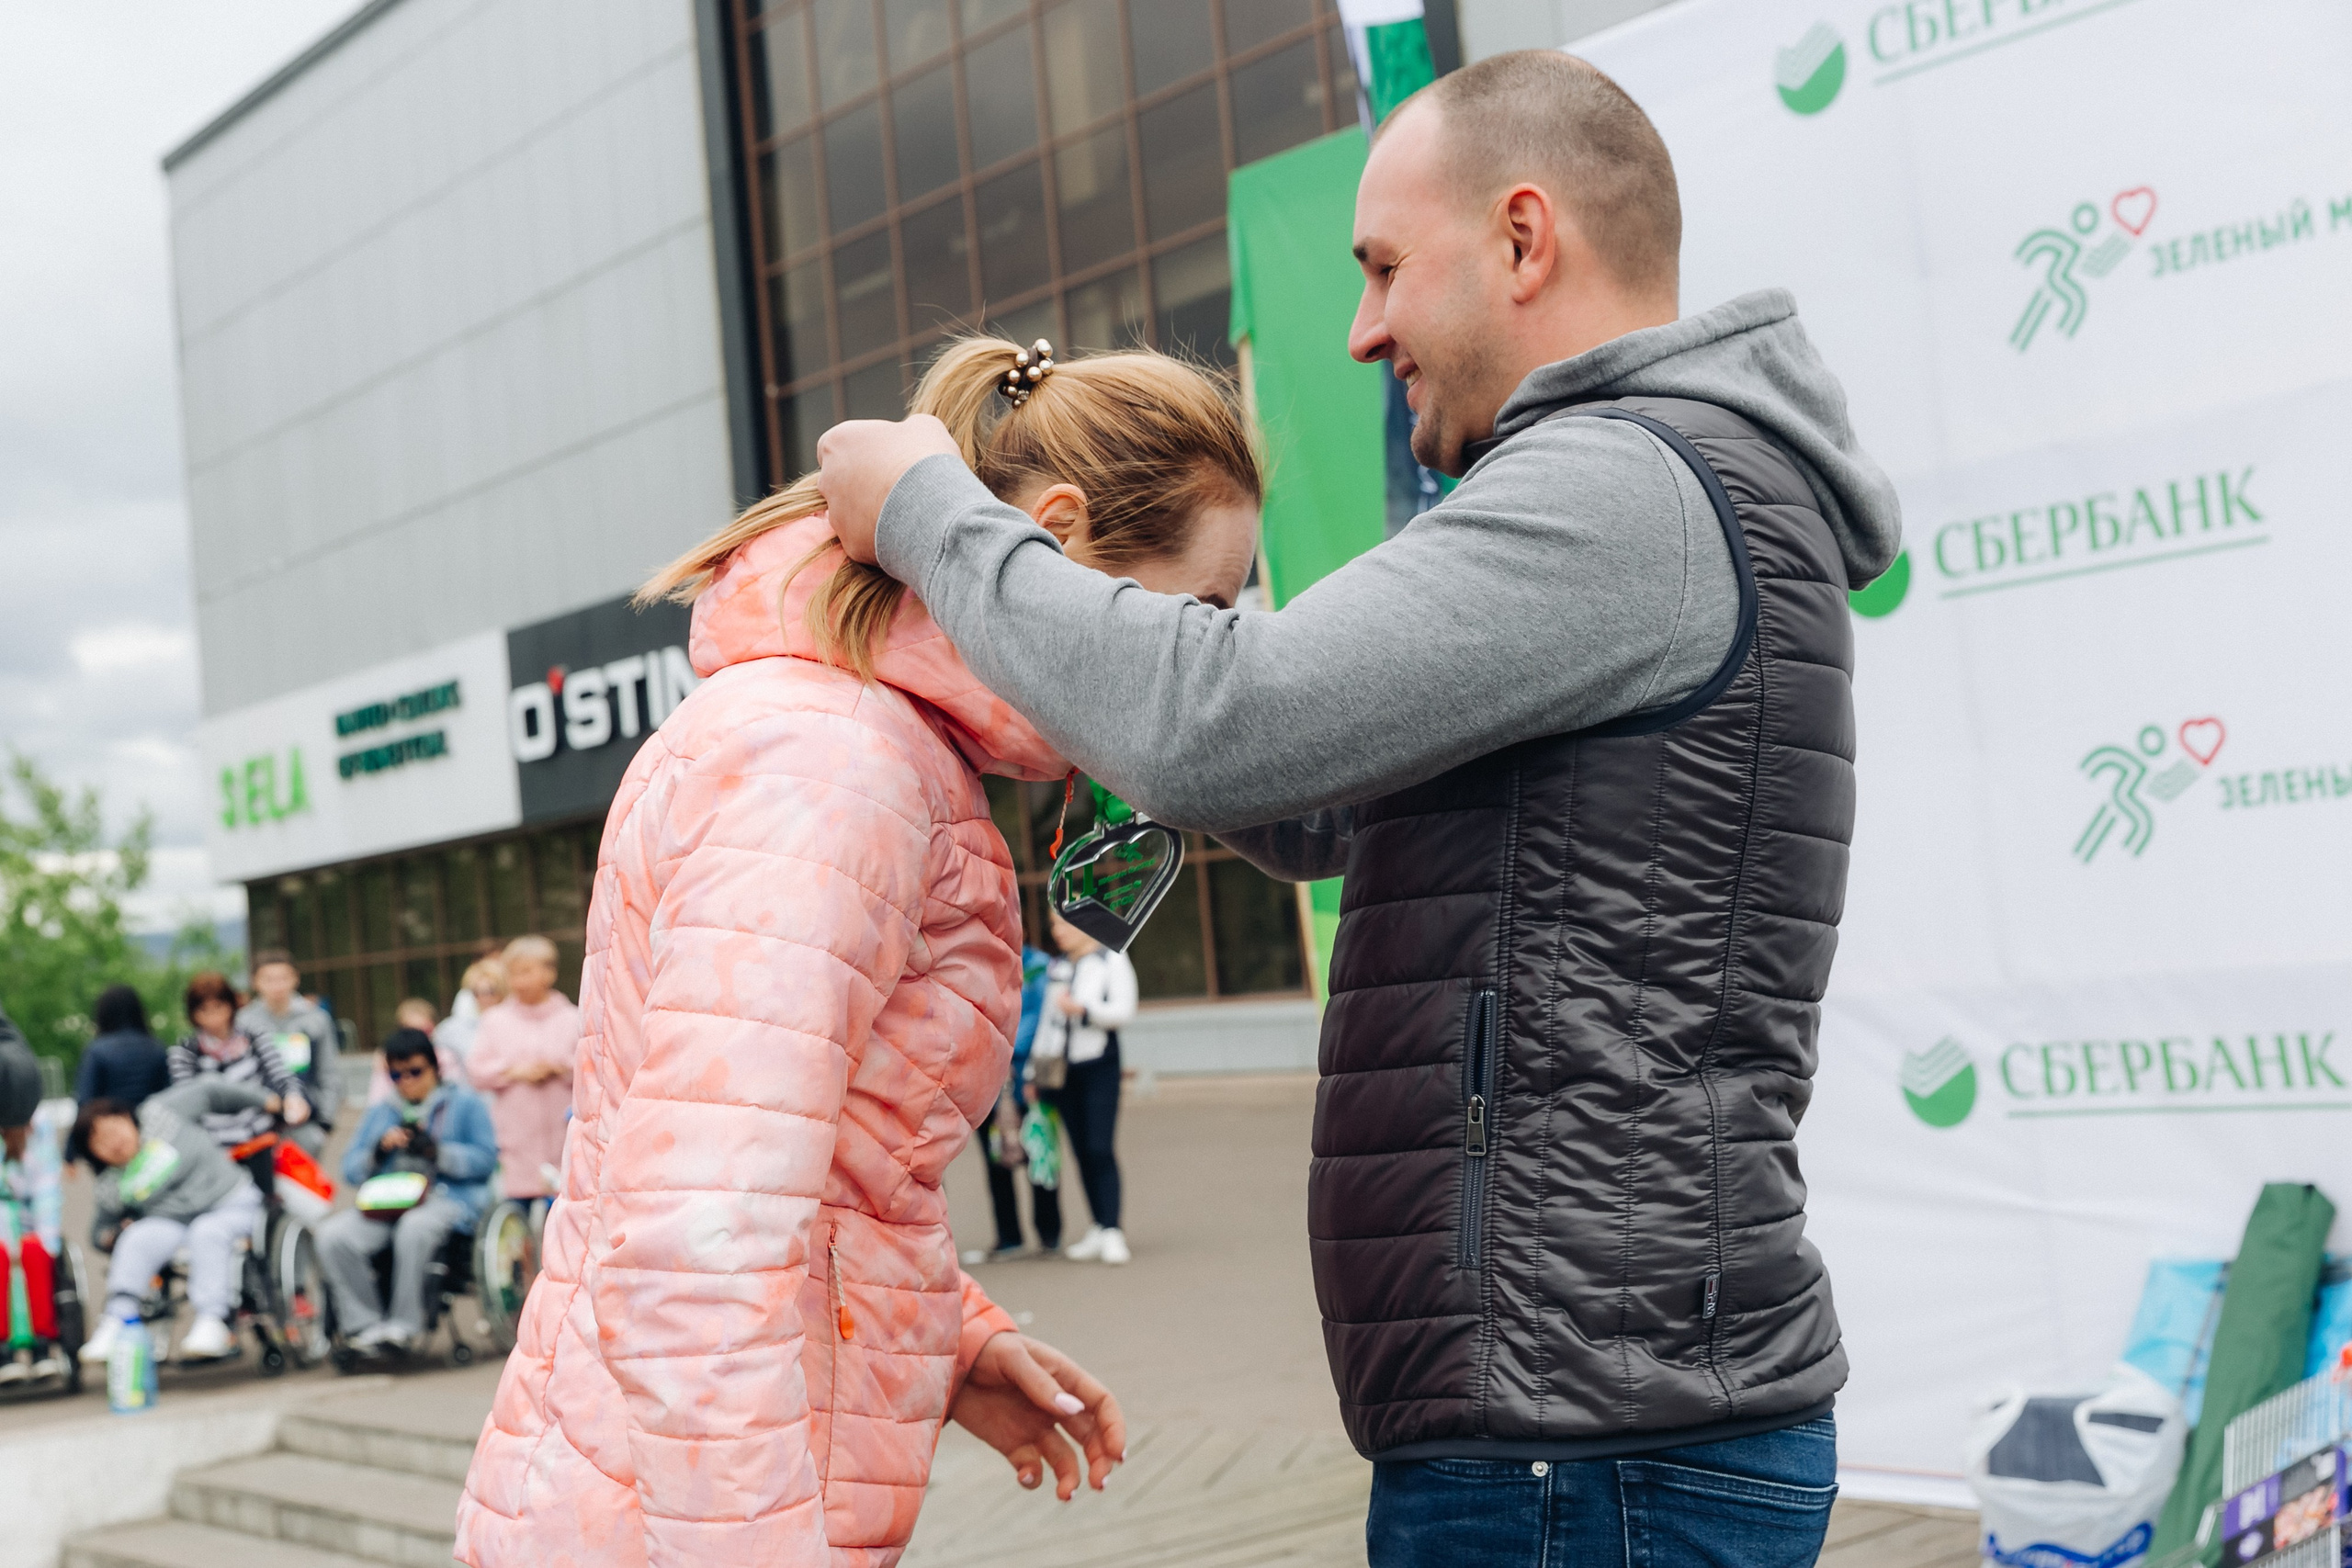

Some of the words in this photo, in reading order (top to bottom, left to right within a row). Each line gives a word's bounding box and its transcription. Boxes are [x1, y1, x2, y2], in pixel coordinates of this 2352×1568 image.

[2149, 197, 2314, 278] ЗЕЛЕНЫЙ
[1932, 465, 2265, 579] СБЕРБАНК
[1999, 1032, 2346, 1100] СБЕРБАНК
